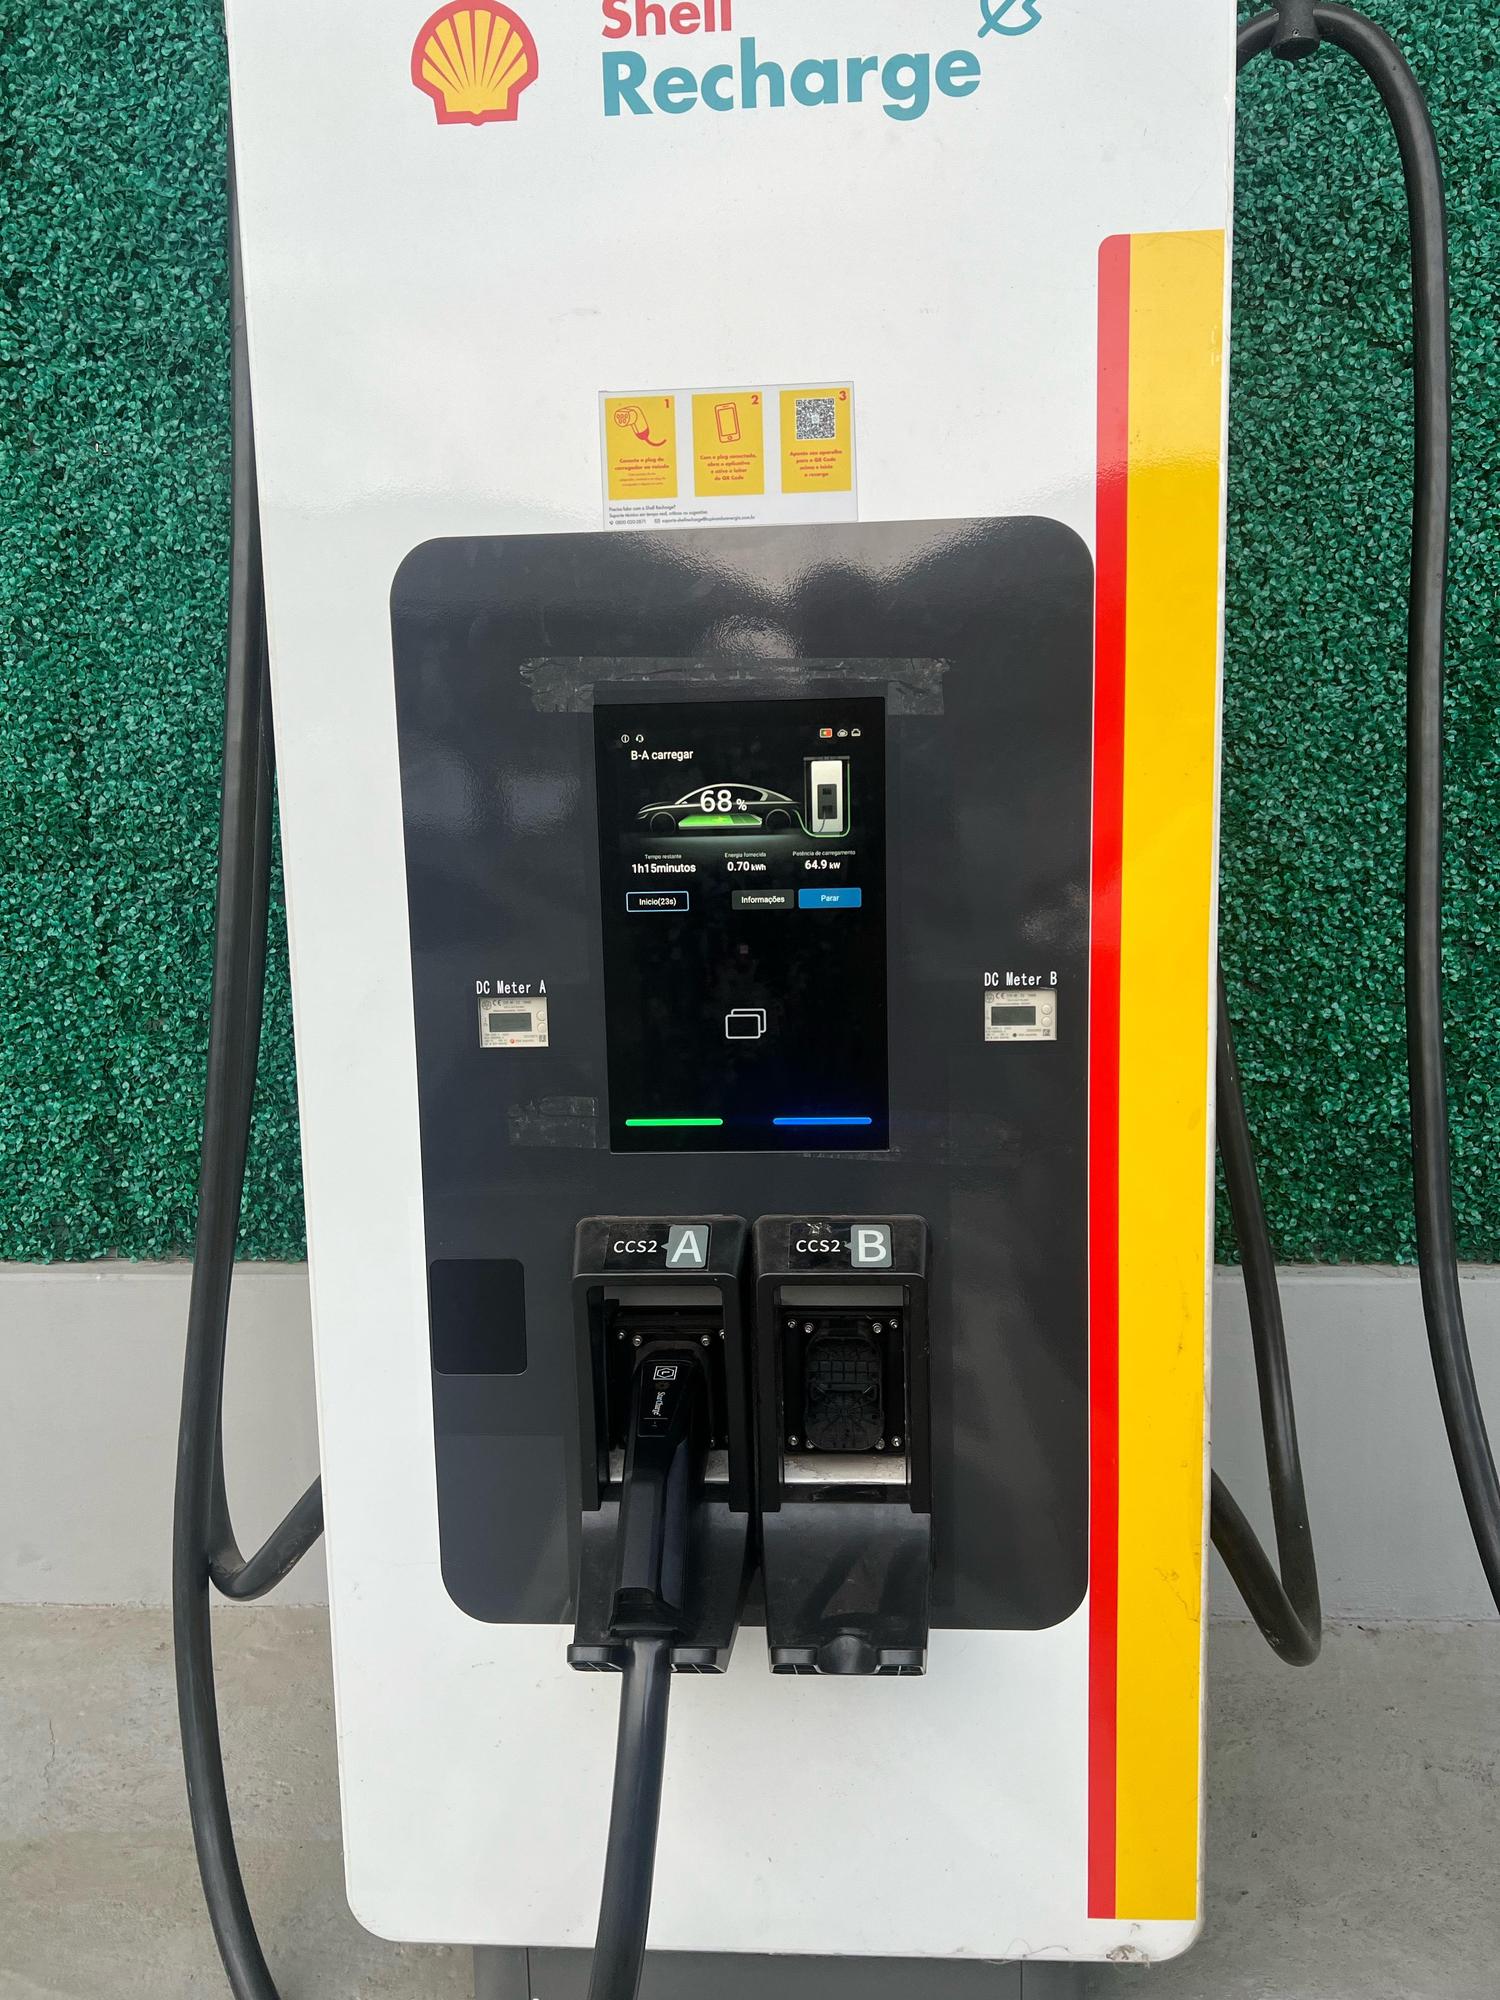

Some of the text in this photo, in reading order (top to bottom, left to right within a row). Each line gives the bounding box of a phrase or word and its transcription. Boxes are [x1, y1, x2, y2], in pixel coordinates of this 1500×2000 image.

[602, 0, 732, 38] Shell
[602, 37, 981, 121] Recharge
[751, 394, 759, 405] 2
[839, 390, 847, 401] 3
[664, 399, 670, 409] 1
[631, 750, 694, 762] B-A carregar
[700, 789, 747, 813] 68 %
[632, 863, 696, 874] 1h15minutos
[727, 861, 767, 871] 0.70 kWh
[805, 859, 841, 870] 64.9 kW
[741, 895, 785, 905] Informações
[820, 894, 840, 902] Parar
[984, 971, 1057, 986] DC Meter B
[476, 979, 546, 994] DC Meter A
[613, 1229, 702, 1263] CCS2 A
[795, 1229, 886, 1262] CCS2 B
